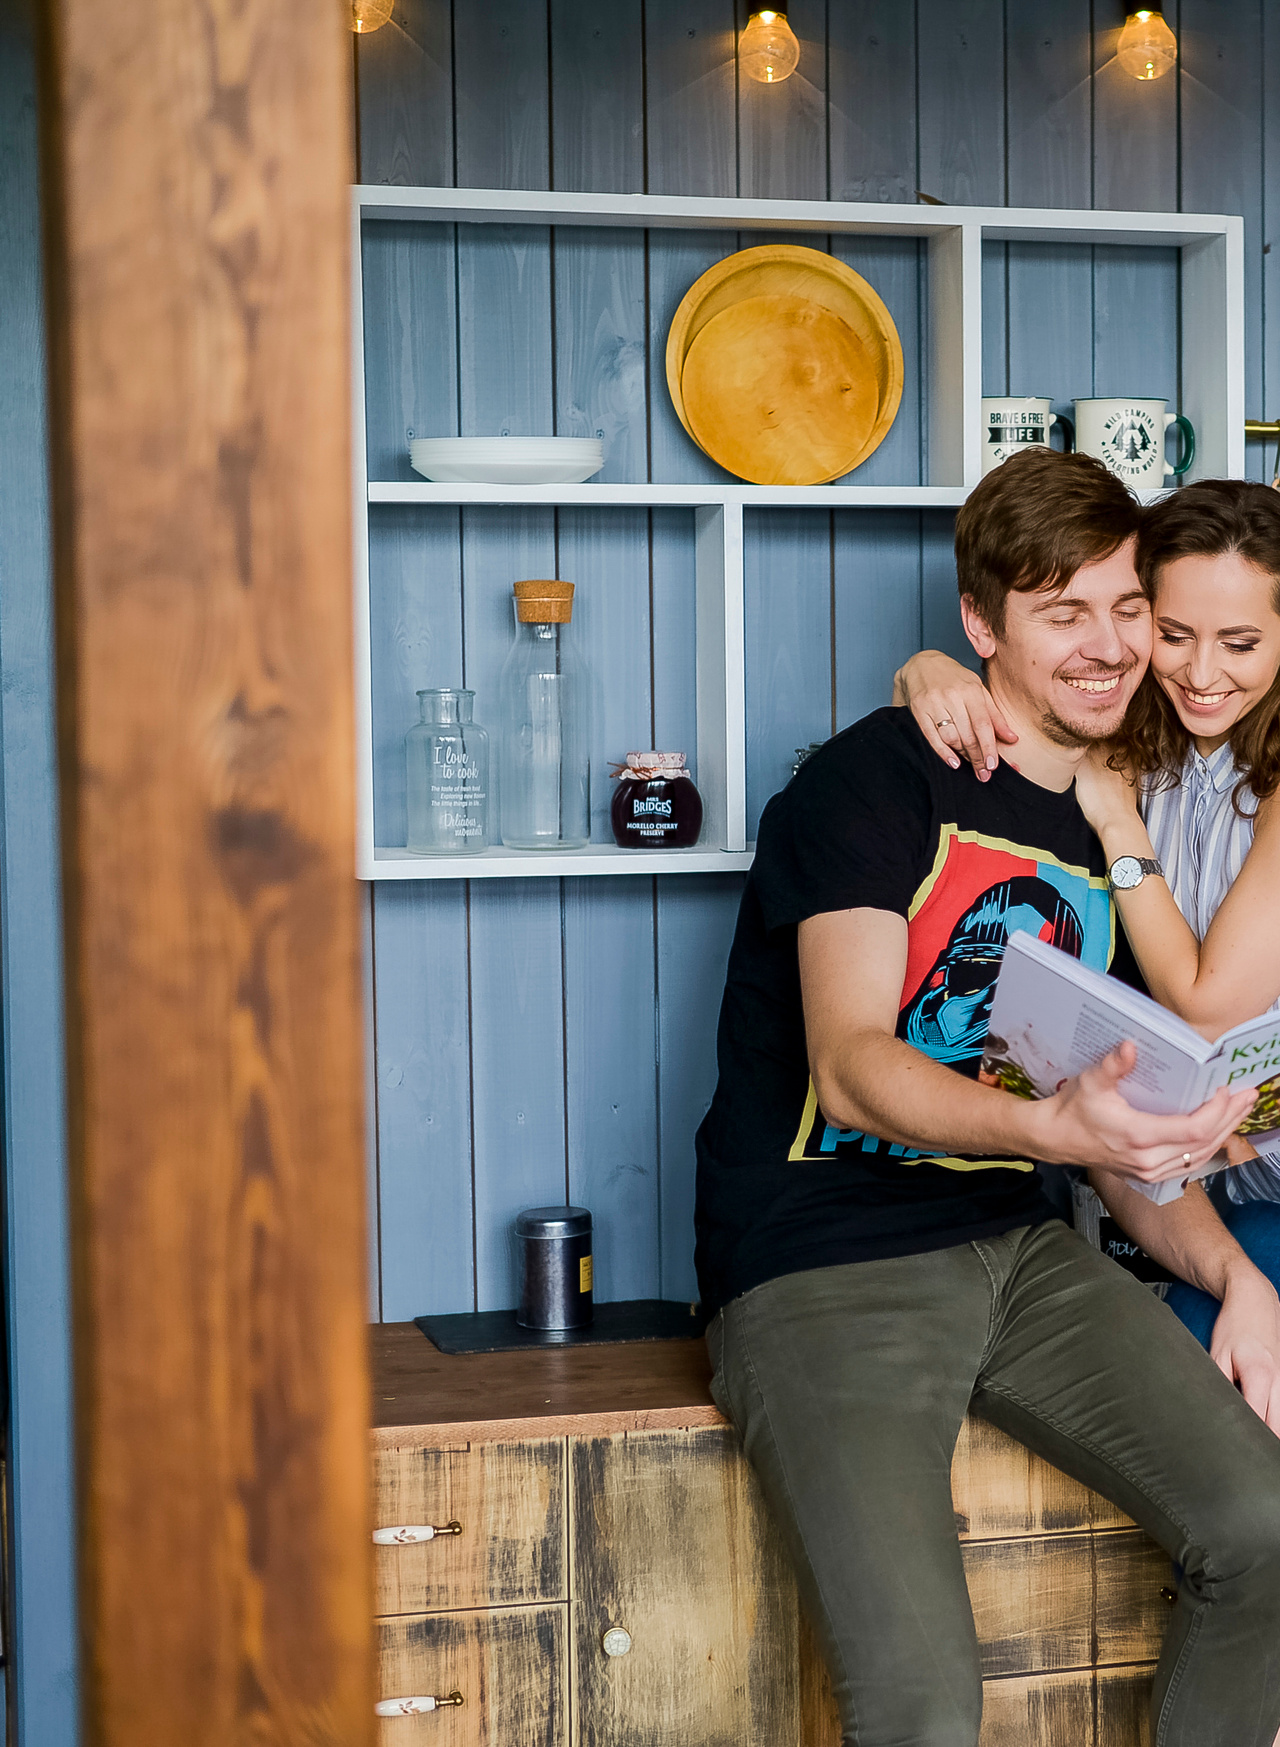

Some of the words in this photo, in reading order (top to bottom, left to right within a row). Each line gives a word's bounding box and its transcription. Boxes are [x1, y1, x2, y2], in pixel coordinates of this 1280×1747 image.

[990, 412, 1019, 424] BRAVE
[1020, 412, 1027, 424] &
[1028, 412, 1044, 425] FREE
[1104, 412, 1122, 430] WILD
[1124, 408, 1155, 429] CAMPING
[1006, 428, 1034, 441] LIFE
[1102, 449, 1140, 475] EXPLORING
[1142, 448, 1158, 471] WORLD
[433, 746, 442, 765] I
[446, 745, 469, 765] love
[440, 764, 455, 779] to
[457, 761, 479, 779] cook
[633, 799, 672, 814] BRIDGES
[444, 811, 476, 828] Delicious
[626, 822, 655, 830] MORELLO
[655, 822, 678, 830] CHERRY
